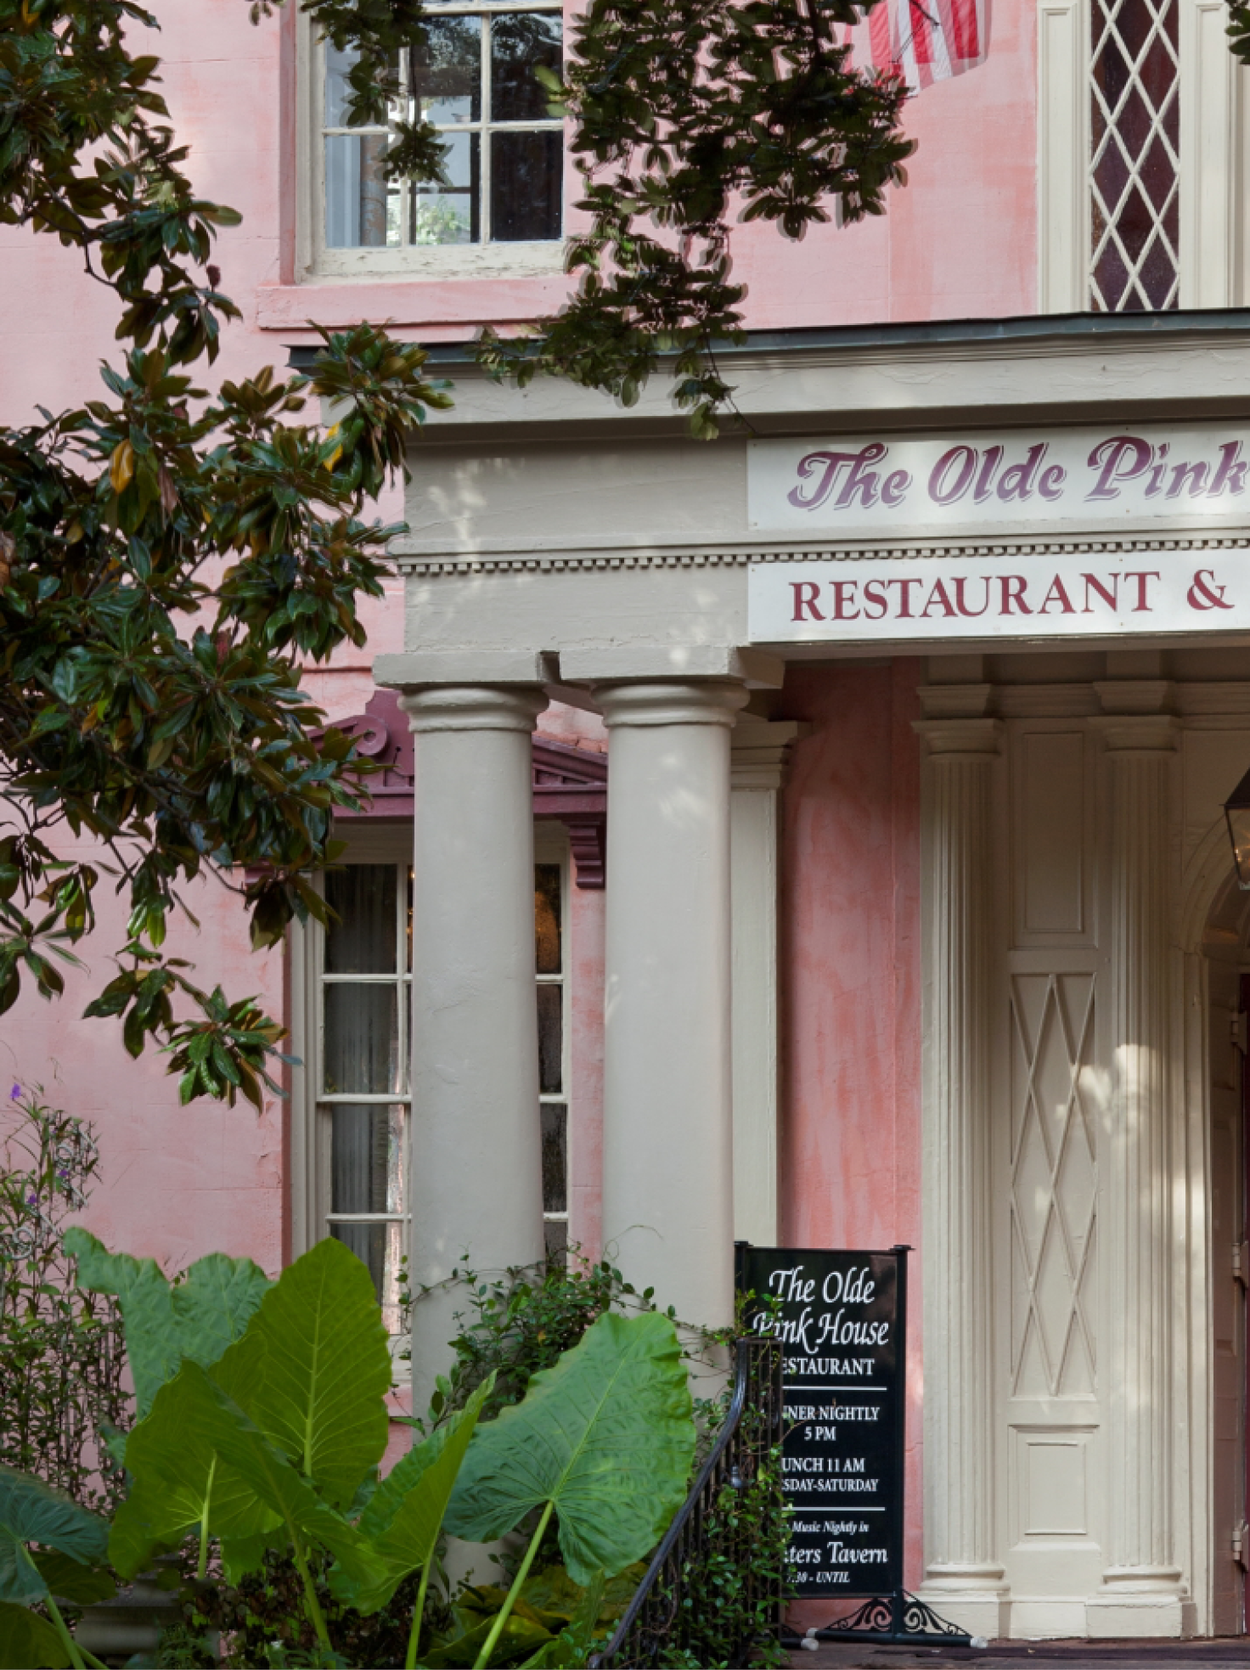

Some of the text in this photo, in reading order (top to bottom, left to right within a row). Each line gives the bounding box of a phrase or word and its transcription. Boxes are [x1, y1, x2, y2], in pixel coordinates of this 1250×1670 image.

[787, 442, 913, 511] The
[928, 441, 1067, 506] Olde
[788, 571, 1161, 622] RESTAURANT
[1186, 569, 1235, 611] &
[768, 1265, 875, 1304] The Olde
[815, 1308, 889, 1345] House
[771, 1358, 875, 1376] ESTAURANT
[818, 1405, 880, 1421] NIGHTLY
[803, 1426, 837, 1441] 5 PM
[781, 1457, 866, 1473] UNCH 11 AM
[791, 1521, 821, 1533] Music
[823, 1521, 858, 1535] Nightly
[858, 1521, 869, 1533] in
[827, 1541, 889, 1564] Tavern
[815, 1571, 850, 1584] UNTIL
